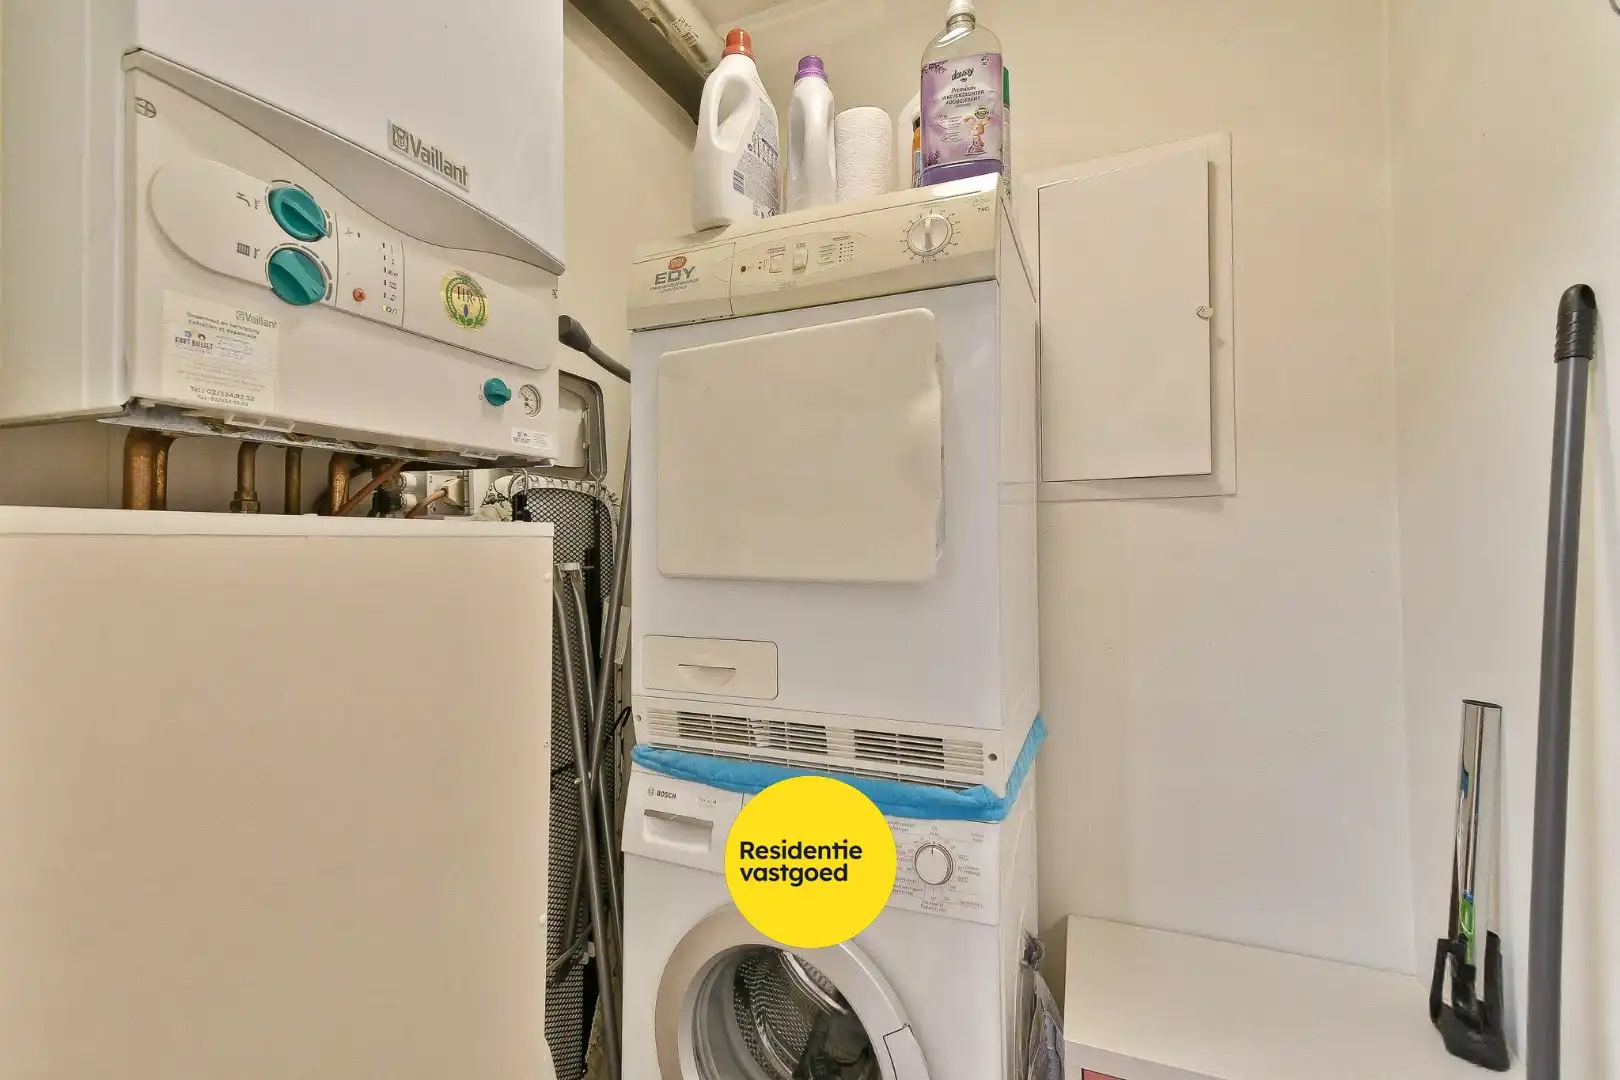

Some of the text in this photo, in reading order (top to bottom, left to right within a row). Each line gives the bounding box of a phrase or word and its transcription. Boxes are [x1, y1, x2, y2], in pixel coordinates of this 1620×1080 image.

[409, 133, 468, 186] Vaillant
[245, 312, 278, 329] Vaillant
[656, 790, 677, 800] BOSCH
